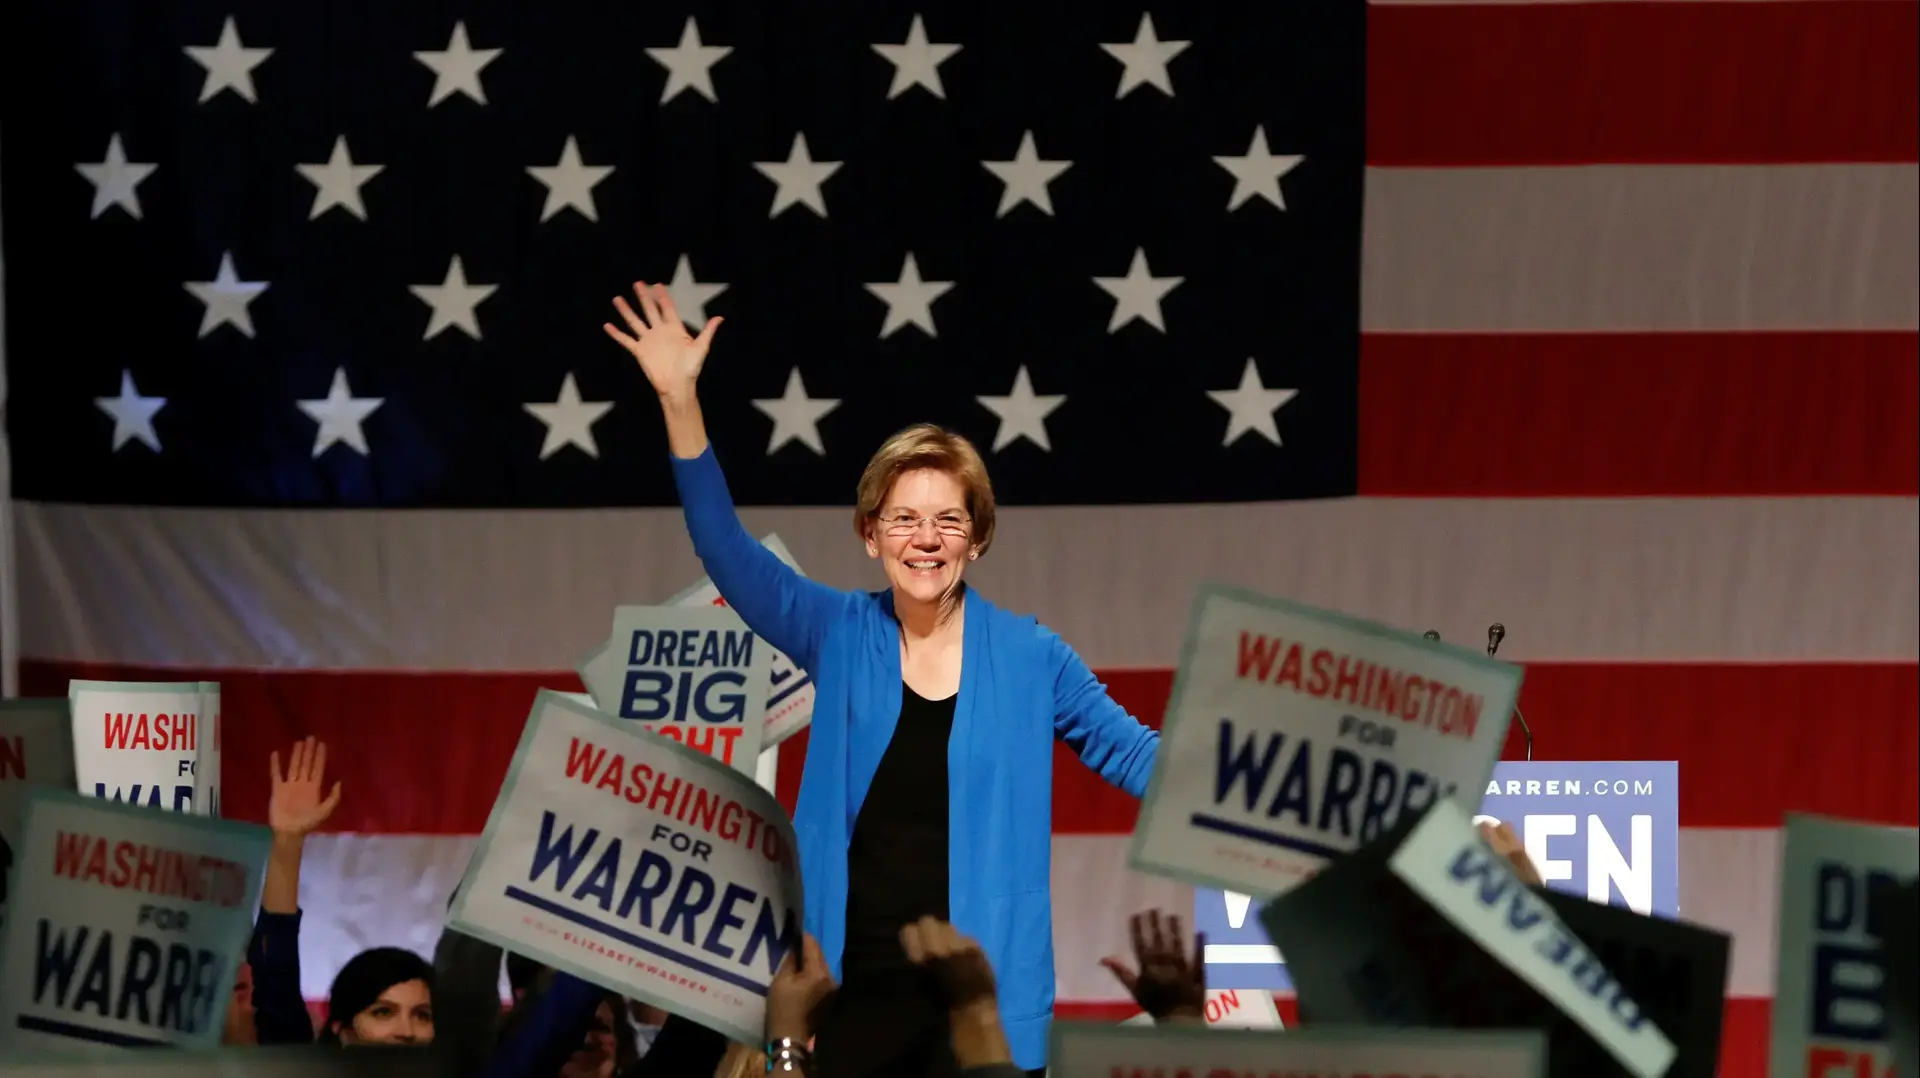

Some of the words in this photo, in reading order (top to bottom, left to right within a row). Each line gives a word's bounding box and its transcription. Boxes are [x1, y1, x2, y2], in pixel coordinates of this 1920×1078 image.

[627, 629, 754, 668] DREAM
[619, 670, 748, 723] BIG
[1237, 630, 1485, 740] WASHINGTON
[1338, 715, 1399, 749] FOR
[651, 823, 713, 862] FOR
[1471, 813, 1654, 918] EN
[137, 904, 192, 934] FOR
[529, 810, 804, 977] WARREN
[1447, 846, 1648, 1034] DREAM
